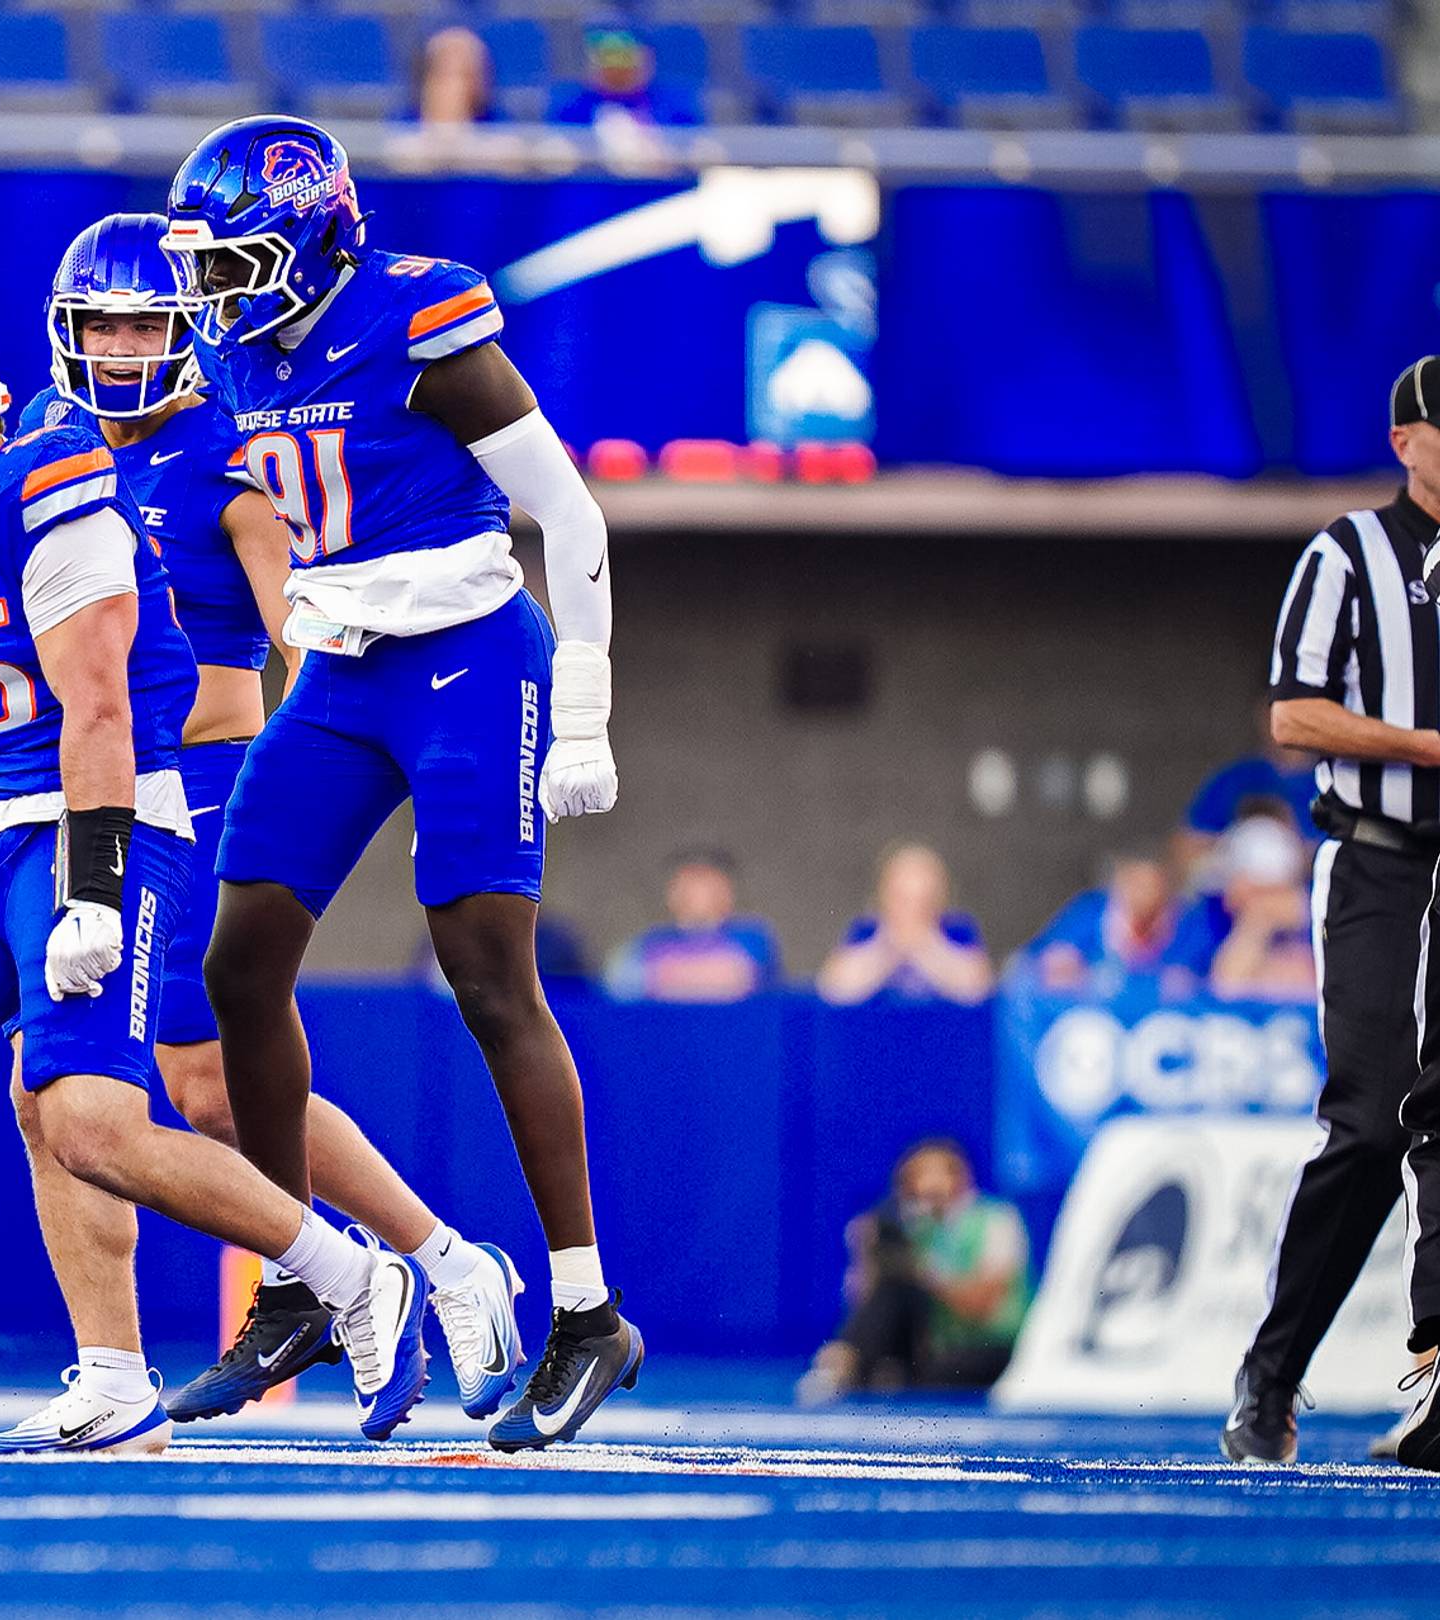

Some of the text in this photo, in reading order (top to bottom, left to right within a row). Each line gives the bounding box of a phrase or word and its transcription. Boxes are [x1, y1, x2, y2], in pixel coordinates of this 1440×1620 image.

[271, 173, 312, 203] BOISE
[296, 178, 334, 206] STATE
[287, 401, 355, 425] STATE
[244, 427, 353, 563] 91
[520, 679, 538, 844] BRONCOS
[129, 886, 157, 1043] BRONCOS
